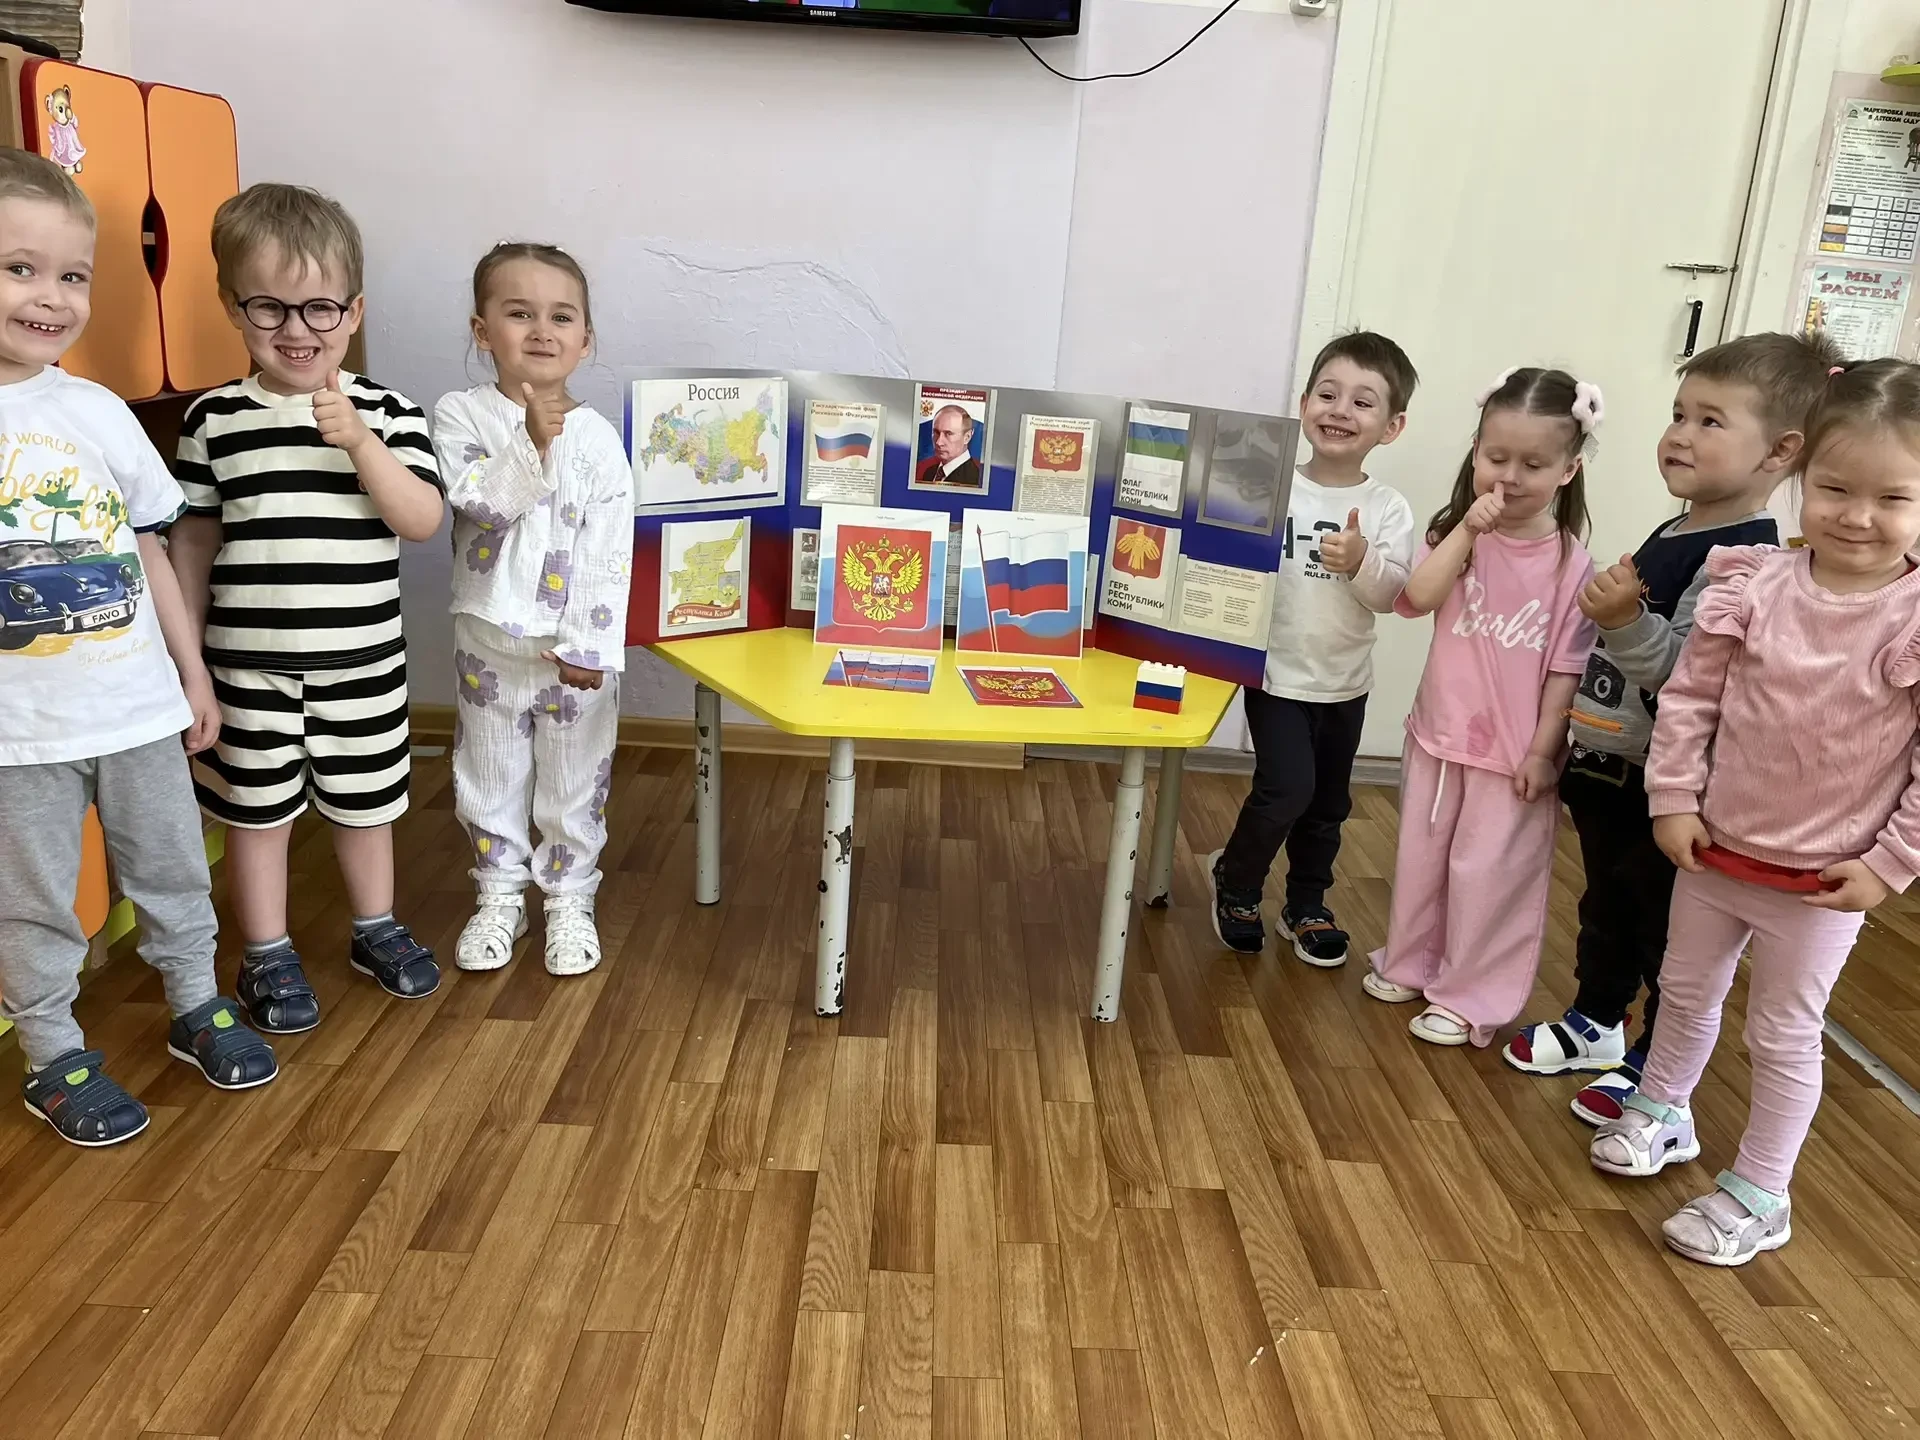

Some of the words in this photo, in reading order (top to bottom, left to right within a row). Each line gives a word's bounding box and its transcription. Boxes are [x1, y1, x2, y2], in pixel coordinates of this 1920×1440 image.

[810, 9, 837, 17] SAMSUNG
[1845, 270, 1882, 284] МЫ
[1820, 283, 1900, 300] РАСТЕМ
[687, 383, 740, 401] Россия
[15, 432, 76, 455] WORLD
[0, 448, 80, 506] bean
[1122, 478, 1142, 488] ФЛАГ
[1120, 495, 1141, 504] КОМИ
[1121, 486, 1169, 502] РЕСПУБЛИКИ
[1304, 571, 1332, 580] RULES
[1109, 580, 1129, 591] ГЕРБ
[1107, 598, 1133, 611] КОМИ
[1108, 588, 1165, 609] РЕСПУБЛИКИ
[92, 609, 120, 624] FAVO
[674, 608, 713, 617] Республика
[714, 609, 732, 617] Коми
[1452, 576, 1551, 652] Barbie
